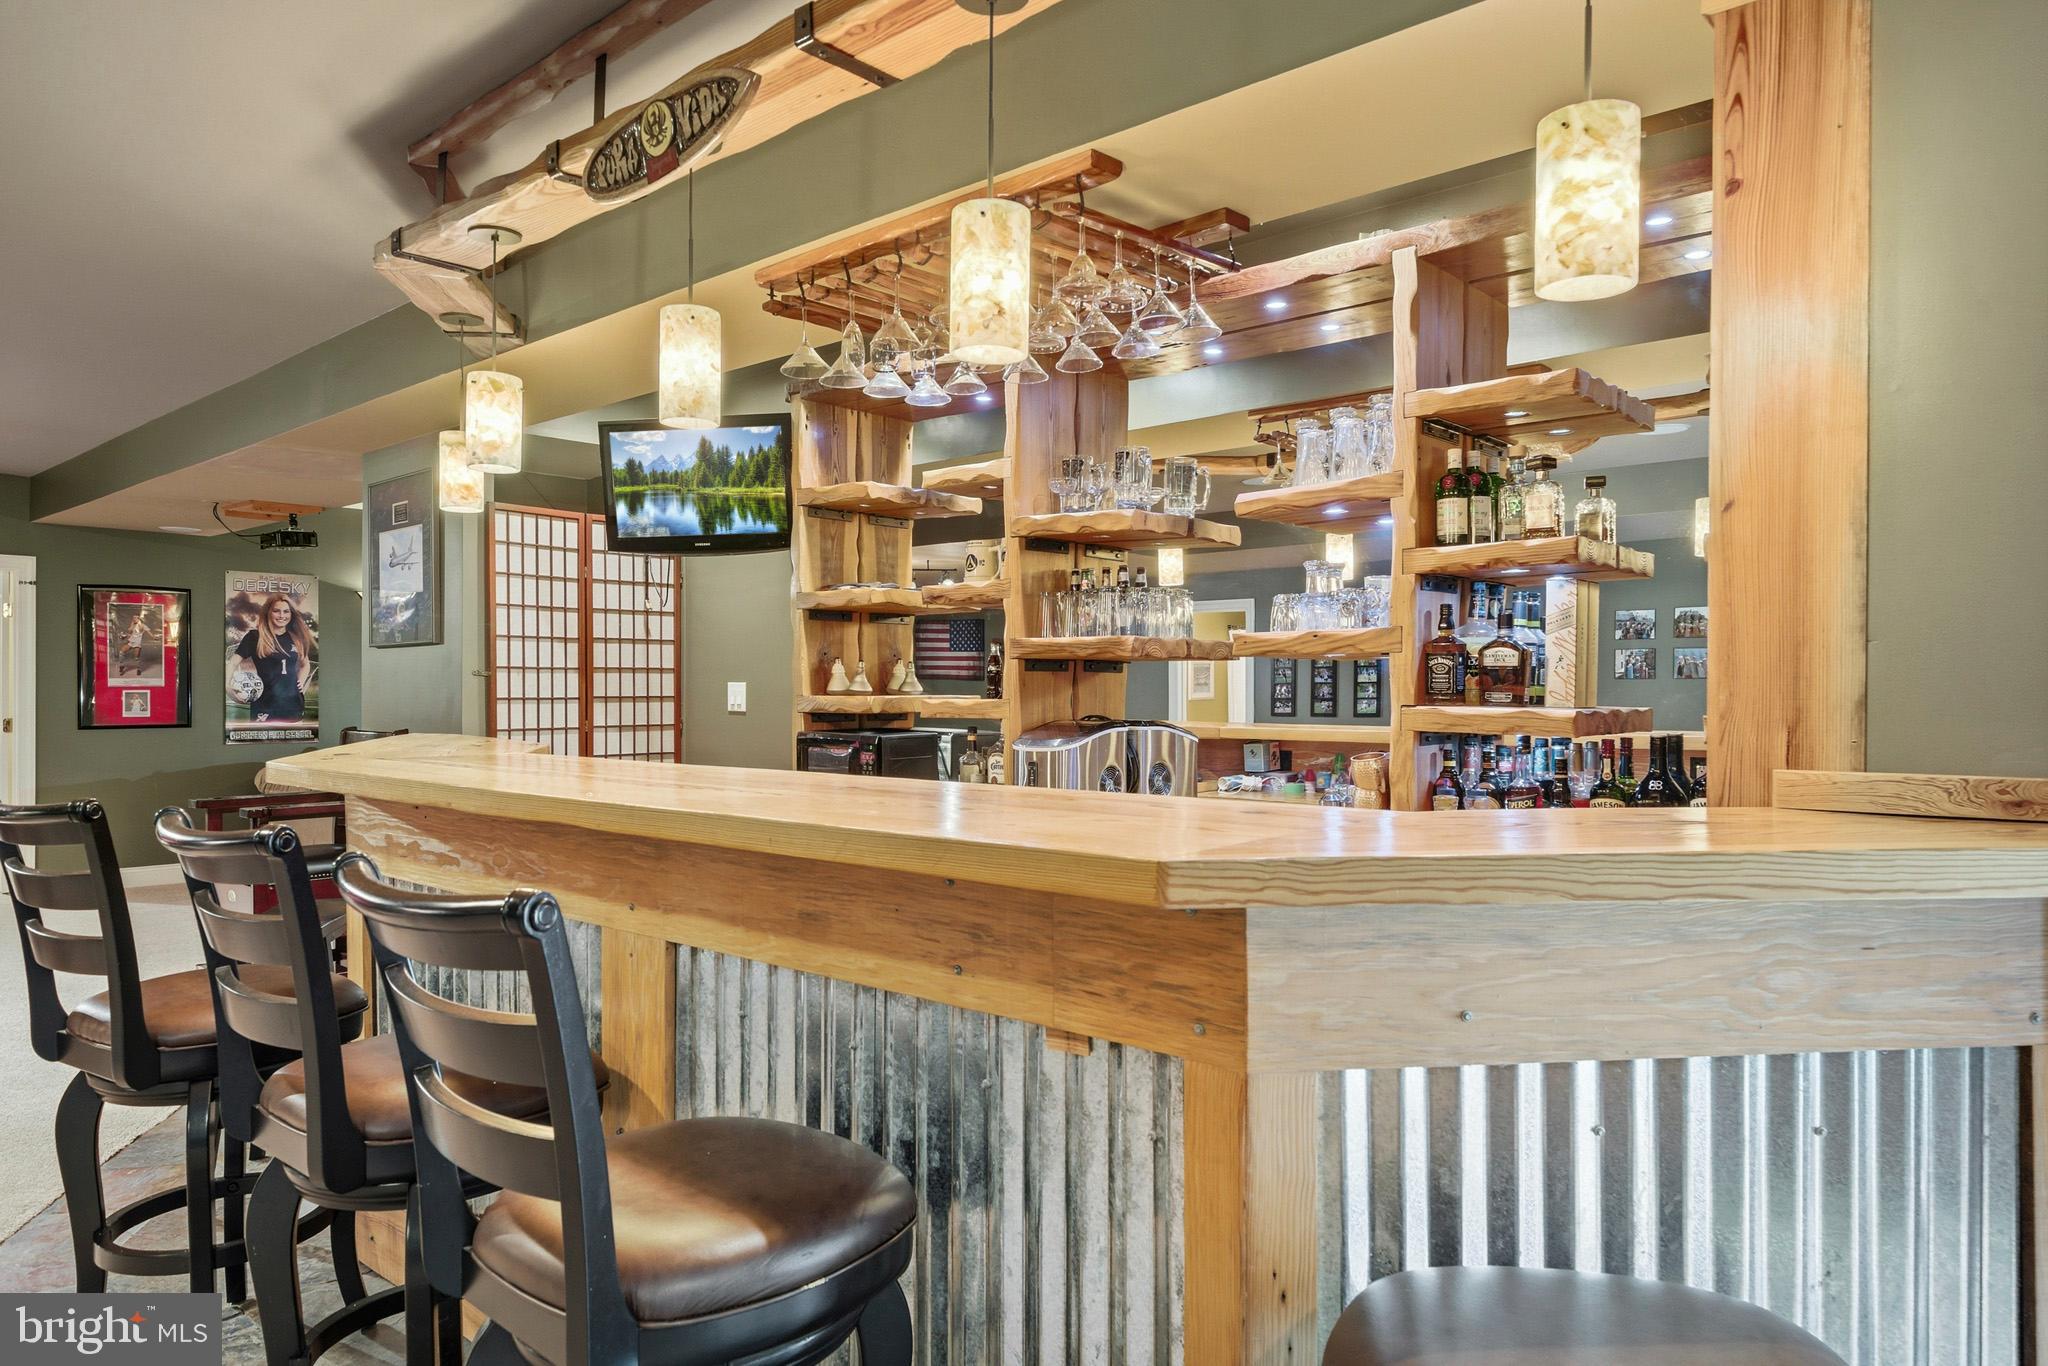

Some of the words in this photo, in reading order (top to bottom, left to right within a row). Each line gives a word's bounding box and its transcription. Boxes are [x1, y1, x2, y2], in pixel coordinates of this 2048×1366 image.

[594, 136, 640, 188] PURA
[233, 577, 311, 595] DERESKY
[281, 658, 288, 675] 1
